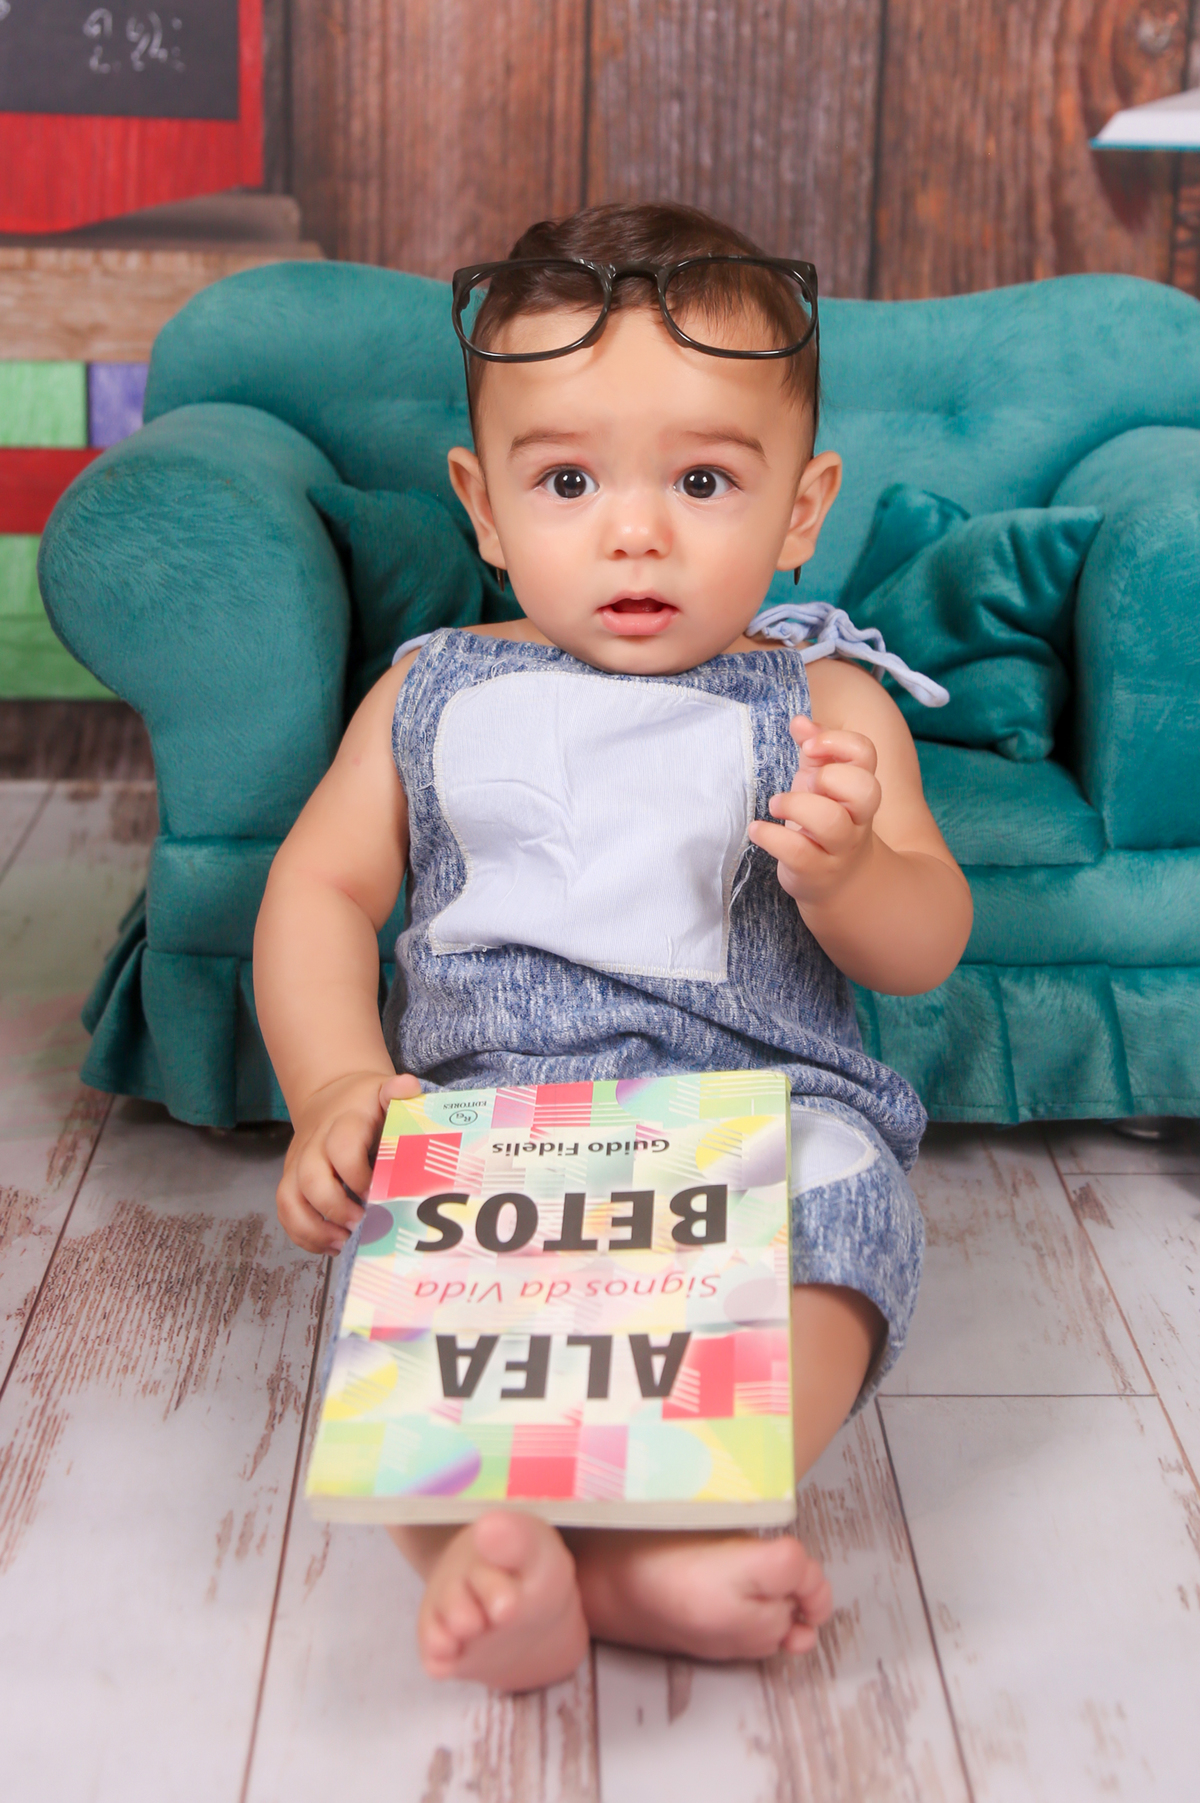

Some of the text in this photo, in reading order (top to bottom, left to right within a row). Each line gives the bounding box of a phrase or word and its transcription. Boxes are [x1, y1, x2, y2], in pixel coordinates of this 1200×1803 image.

[443, 1100, 487, 1110] EDITORES
[492, 1139, 671, 1157] Guido Fidelis
[414, 1184, 728, 1253] BETOS
[414, 1271, 721, 1304] Signos da Vida
[435, 1331, 692, 1400] ALFA
